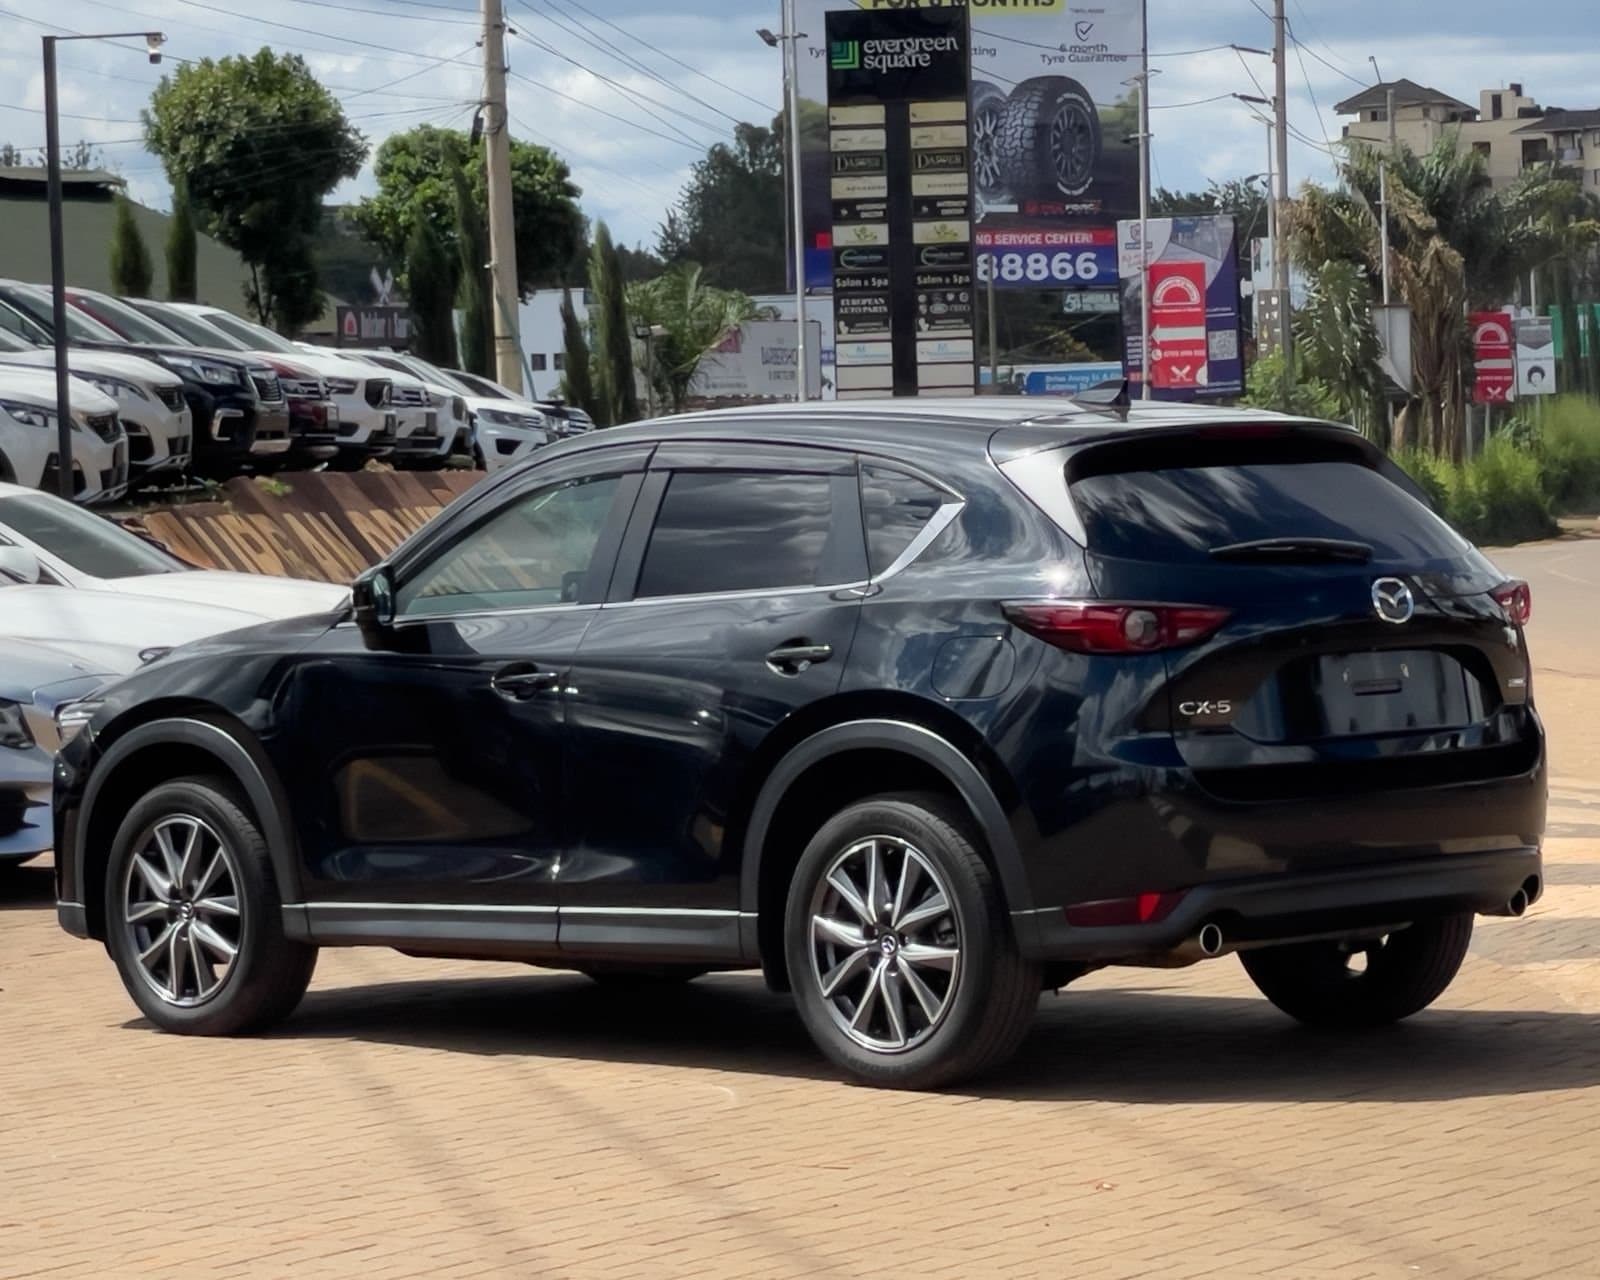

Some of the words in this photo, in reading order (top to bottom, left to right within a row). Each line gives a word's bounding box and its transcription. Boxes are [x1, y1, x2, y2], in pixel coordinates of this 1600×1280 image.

[863, 36, 959, 55] evergreen
[1070, 44, 1108, 53] month
[863, 52, 931, 74] square
[1040, 54, 1065, 65] Tyre
[1069, 54, 1128, 63] Guarantee
[994, 232, 1043, 246] SERVICE
[1044, 231, 1094, 245] CENTER!
[976, 252, 1098, 281] 88866
[872, 277, 889, 287] Spa
[953, 274, 970, 285] Spa
[1179, 700, 1231, 715] CX-5
